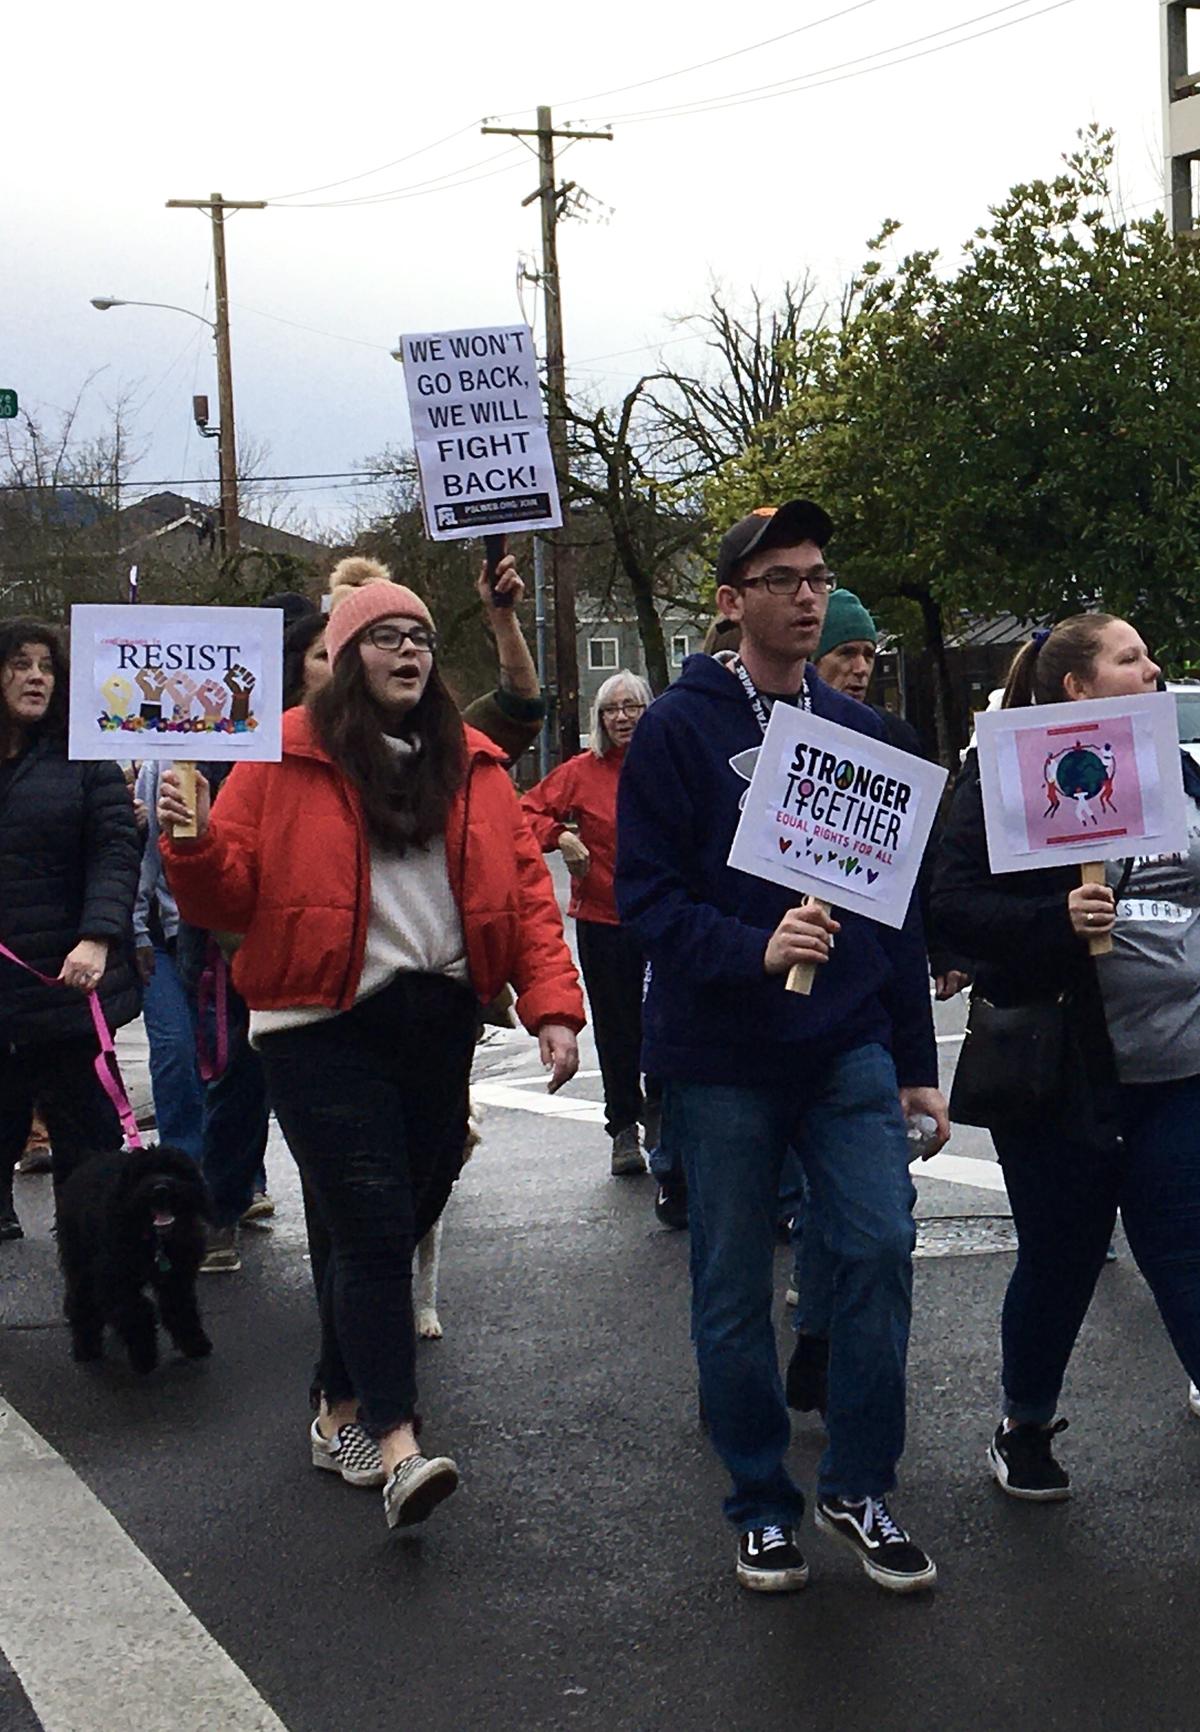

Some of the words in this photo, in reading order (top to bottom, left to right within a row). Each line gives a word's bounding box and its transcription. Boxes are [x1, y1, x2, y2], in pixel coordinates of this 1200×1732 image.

[409, 340, 445, 363] WE
[449, 332, 524, 359] WON'T
[417, 373, 452, 396] GO
[459, 365, 529, 392] BACK,
[428, 405, 466, 429] WE
[470, 399, 528, 425] WILL
[438, 431, 529, 462] FIGHT
[443, 465, 537, 497] BACK!
[117, 643, 241, 671] RESIST
[791, 743, 911, 814] STRONGER
[783, 773, 901, 850] TOGETHER
[776, 810, 808, 832] EQUAL
[813, 825, 850, 848] RIGHTS
[853, 841, 874, 857] FOR
[875, 850, 893, 865] ALL
